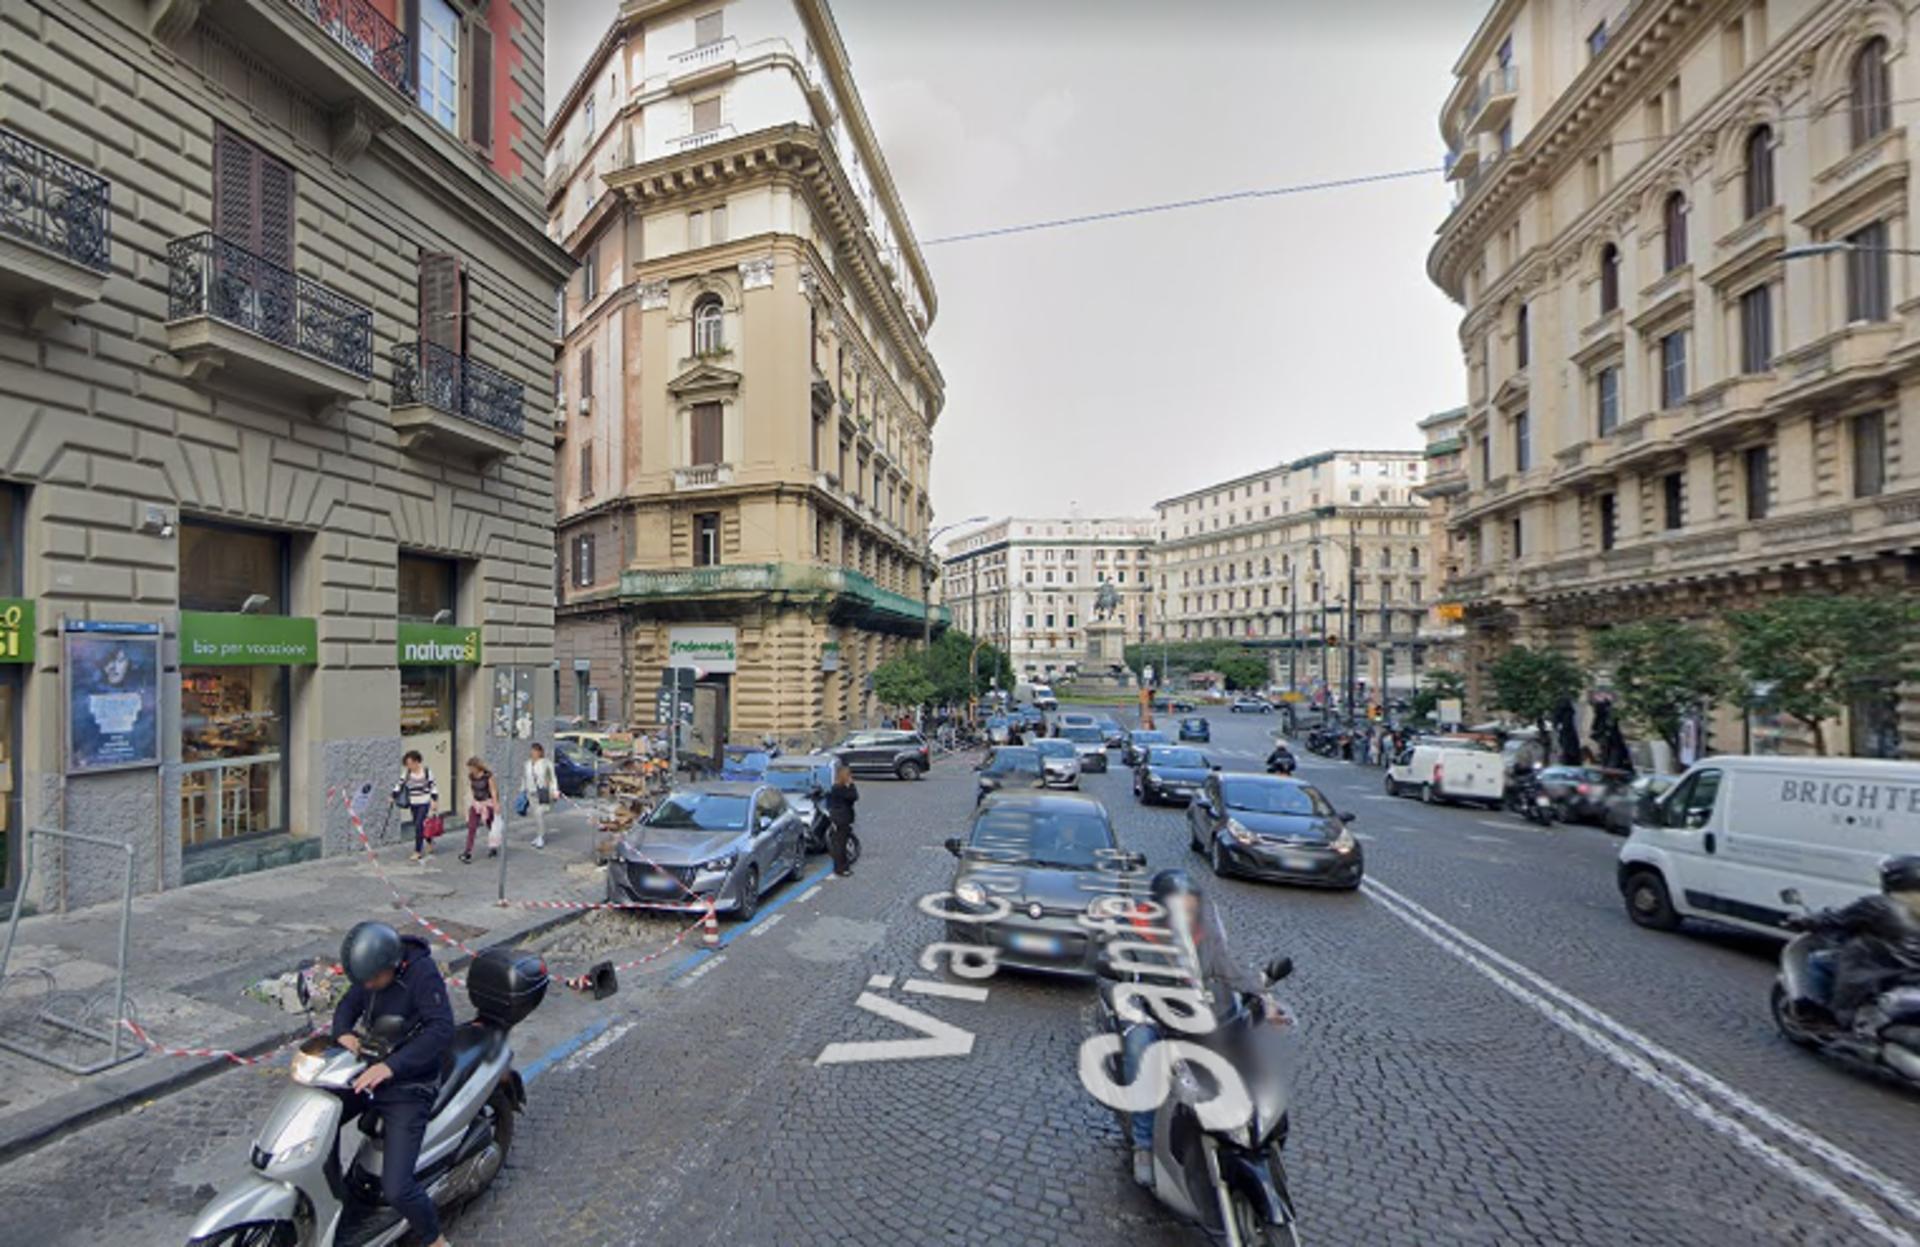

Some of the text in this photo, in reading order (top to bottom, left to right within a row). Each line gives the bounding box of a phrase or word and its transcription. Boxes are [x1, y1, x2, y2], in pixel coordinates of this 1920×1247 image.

[193, 640, 307, 657] bio per vocazione
